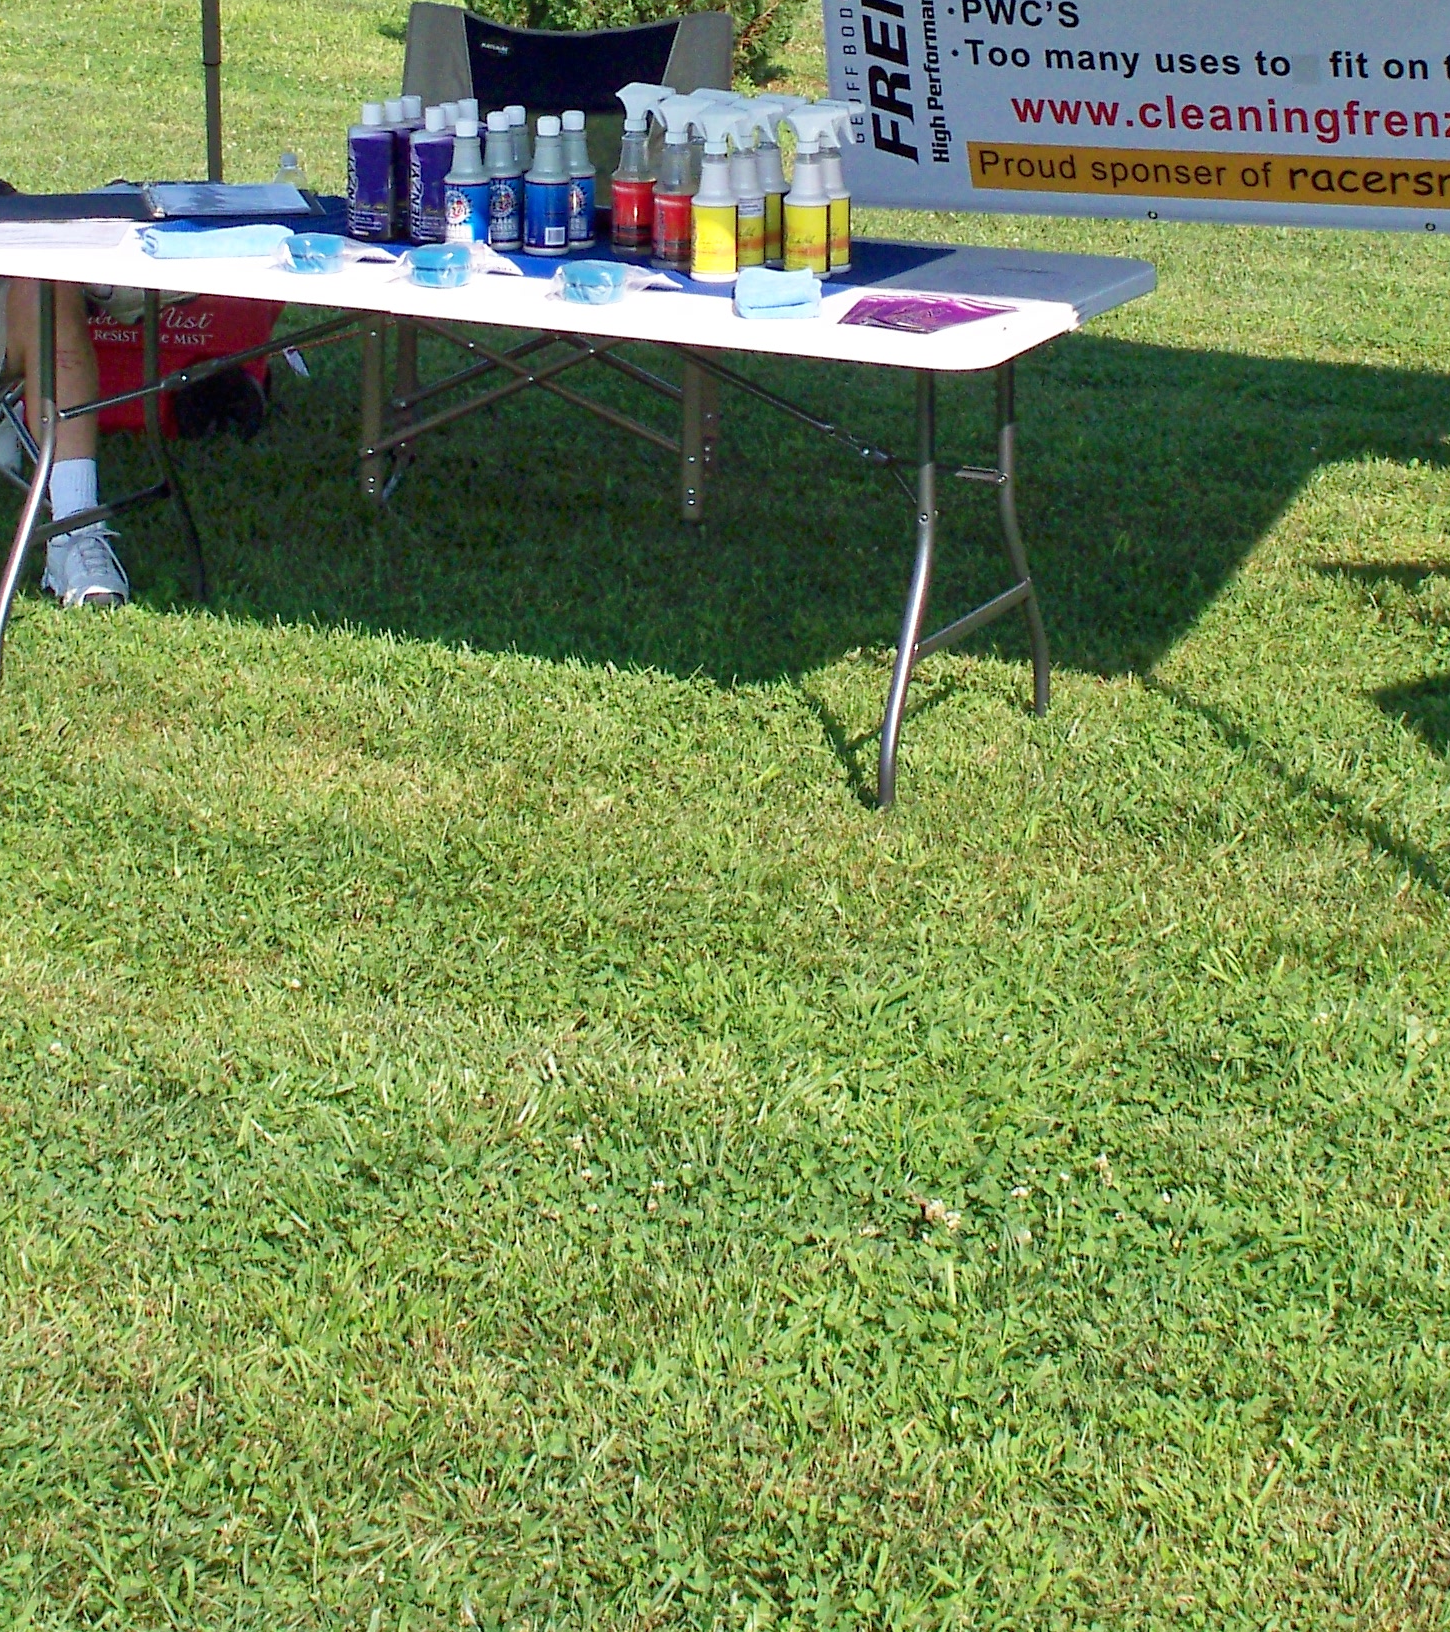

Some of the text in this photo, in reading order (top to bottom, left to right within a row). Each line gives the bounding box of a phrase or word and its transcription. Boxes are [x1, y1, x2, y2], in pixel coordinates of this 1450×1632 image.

[965, 39, 1031, 68] Too
[1045, 49, 1139, 79] many
[1155, 51, 1241, 76] uses
[1255, 50, 1291, 77] to
[1329, 51, 1369, 80] fit
[1383, 57, 1429, 81] on
[930, 116, 952, 163] High
[979, 149, 1077, 180] Proud
[1091, 158, 1227, 188] sponser
[1241, 161, 1273, 188] of
